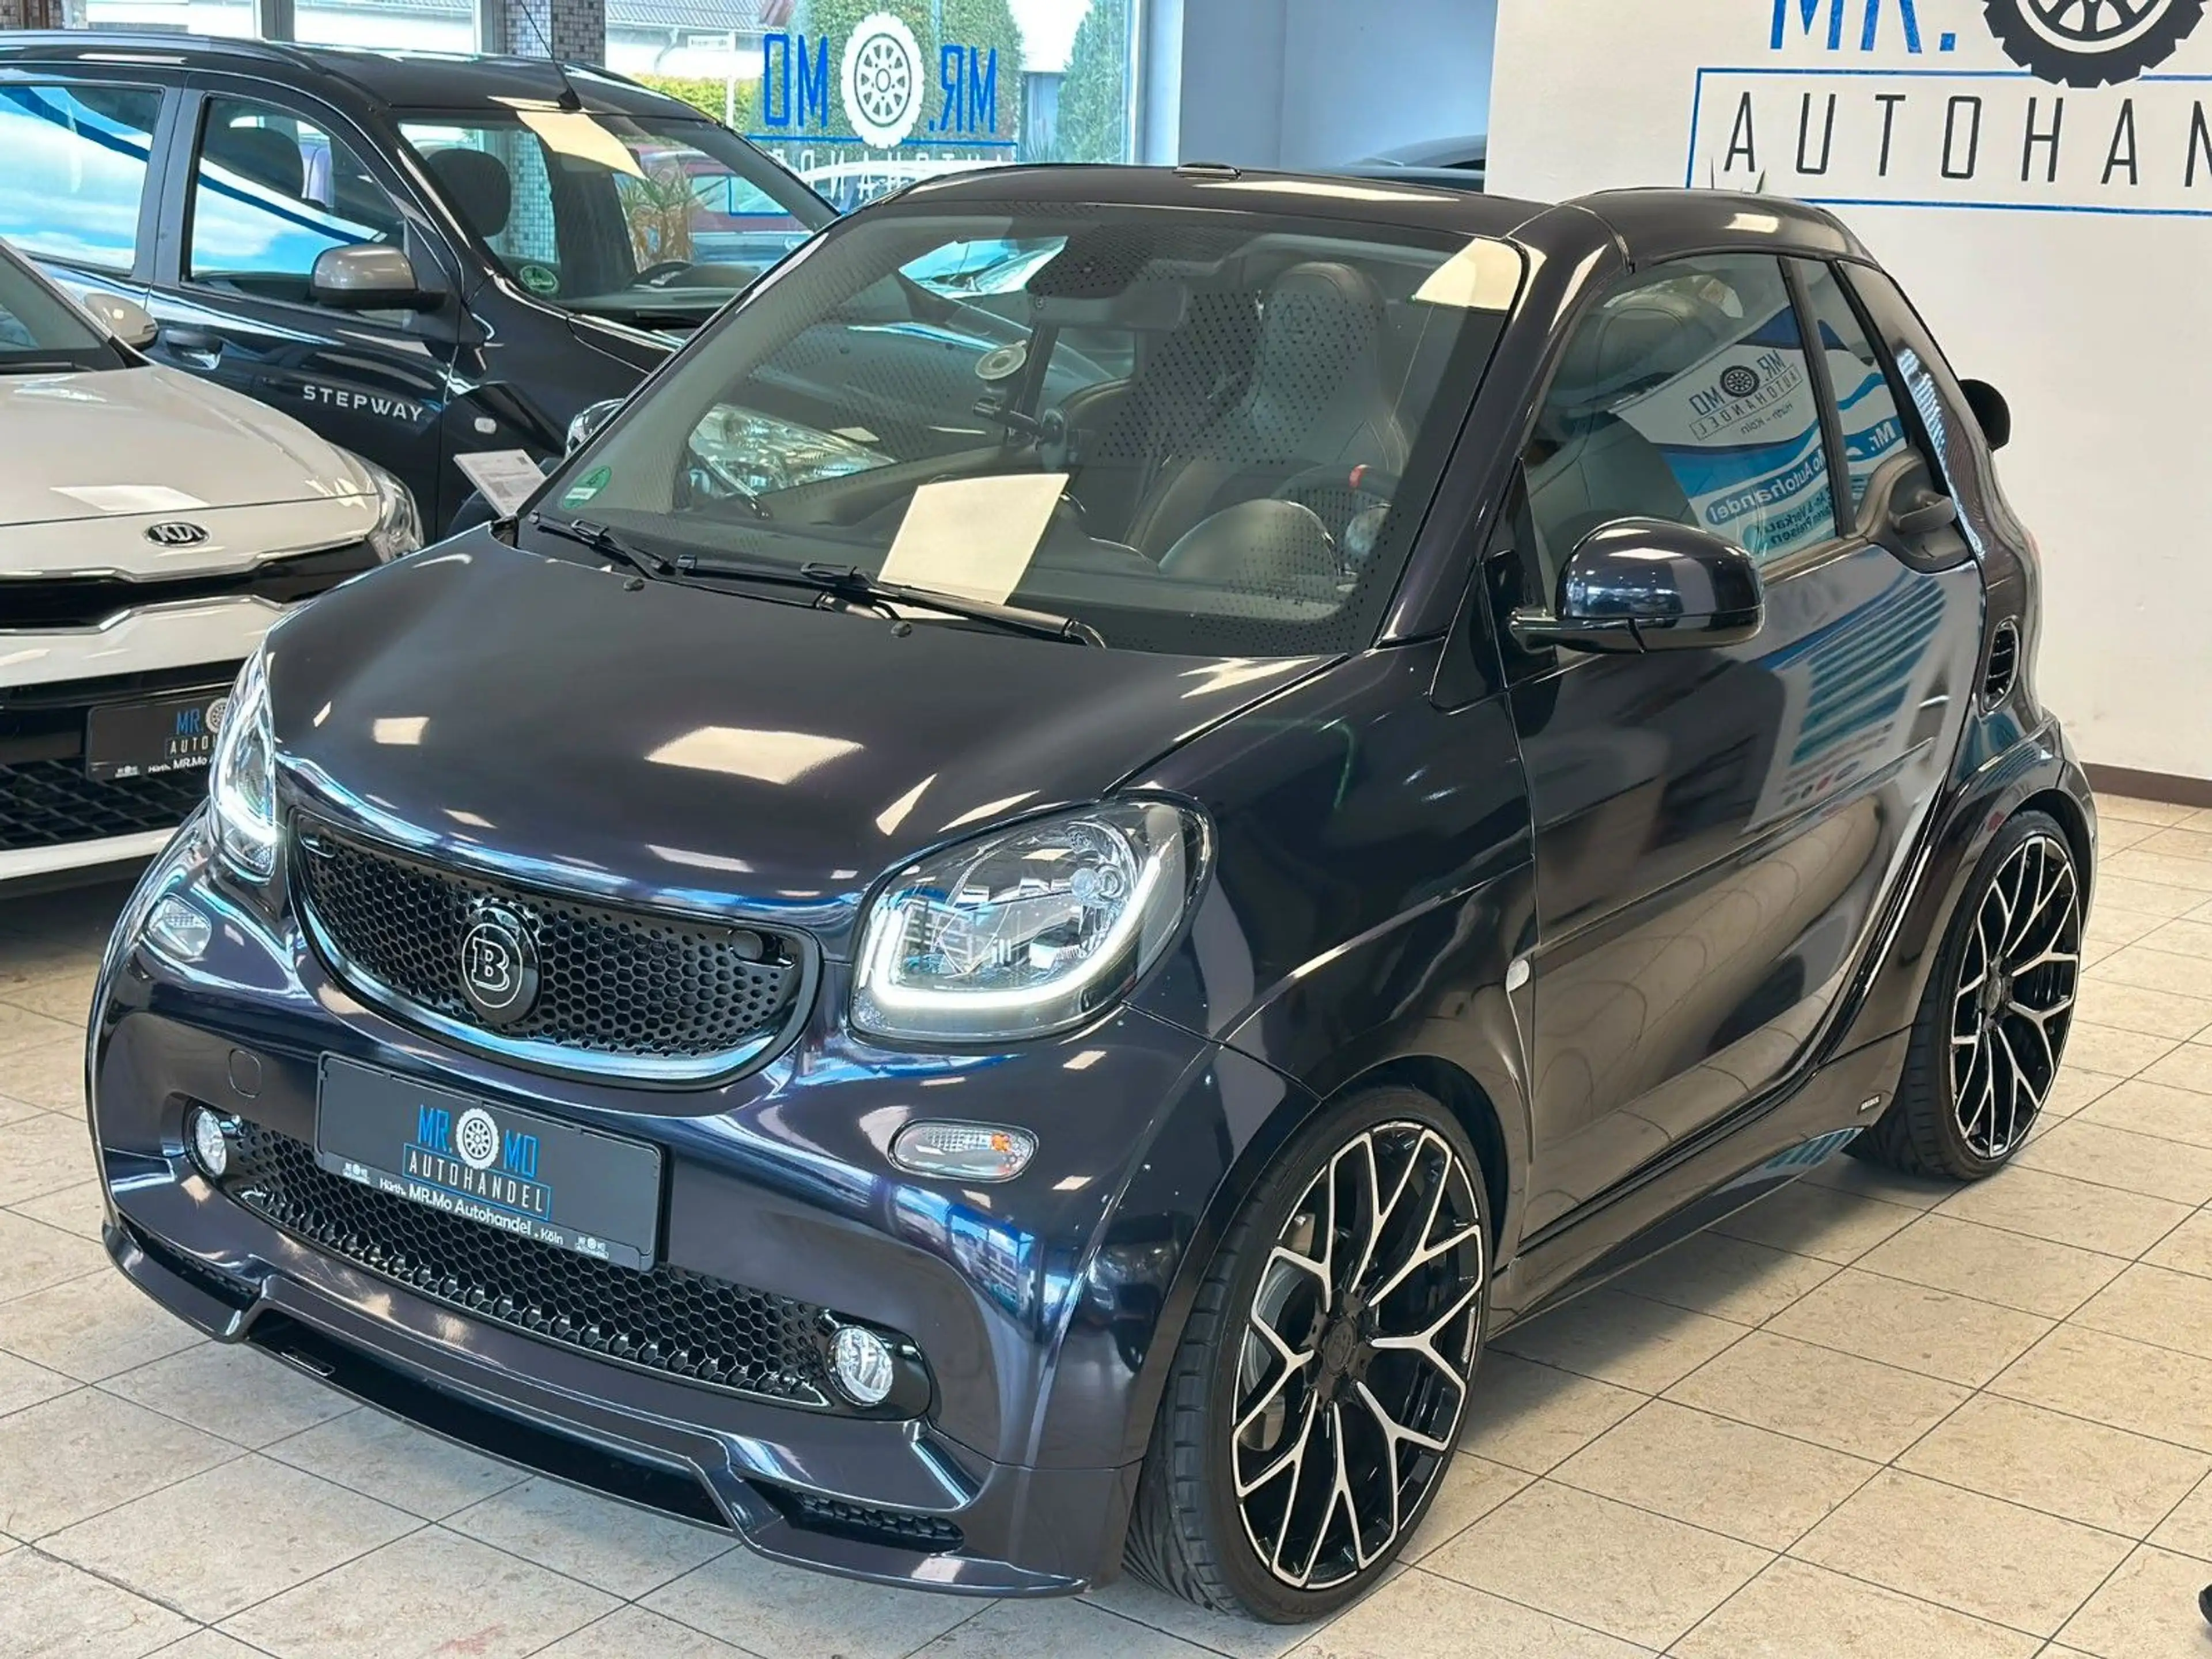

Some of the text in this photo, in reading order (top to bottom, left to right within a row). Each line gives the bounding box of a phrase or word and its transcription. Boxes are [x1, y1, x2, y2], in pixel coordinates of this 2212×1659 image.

[303, 385, 425, 422] STEPWAY
[152, 524, 203, 541] KIA
[472, 936, 510, 992] B
[418, 1104, 539, 1177] MR. MO
[410, 1150, 543, 1213] AUTOHANDEL
[409, 1183, 452, 1210] MR.Mo
[454, 1198, 532, 1235] Autohandel
[540, 1227, 564, 1246] Köln
